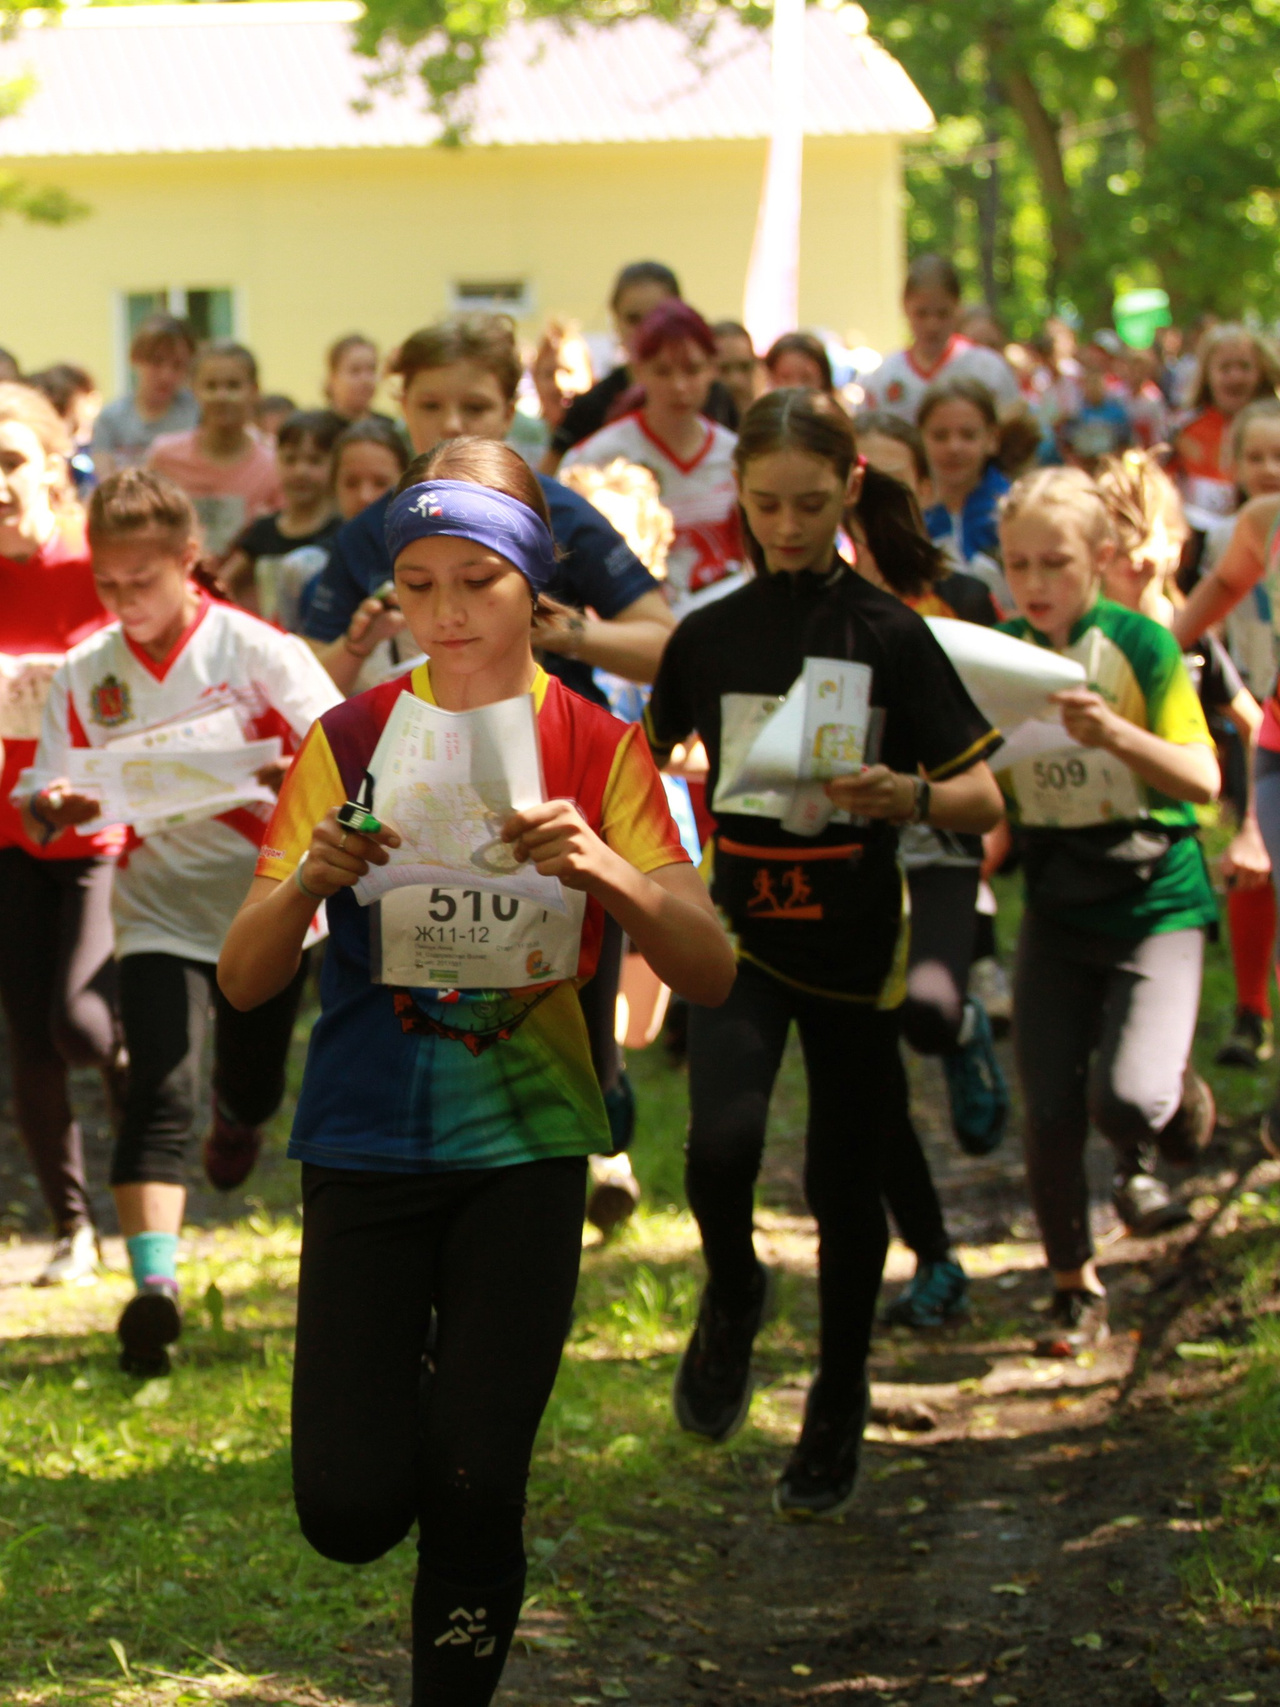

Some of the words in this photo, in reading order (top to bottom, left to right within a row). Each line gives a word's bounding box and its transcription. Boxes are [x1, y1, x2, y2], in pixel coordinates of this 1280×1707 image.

[1032, 758, 1088, 790] 509
[428, 887, 519, 922] 510
[414, 926, 490, 943] Ж11-12
